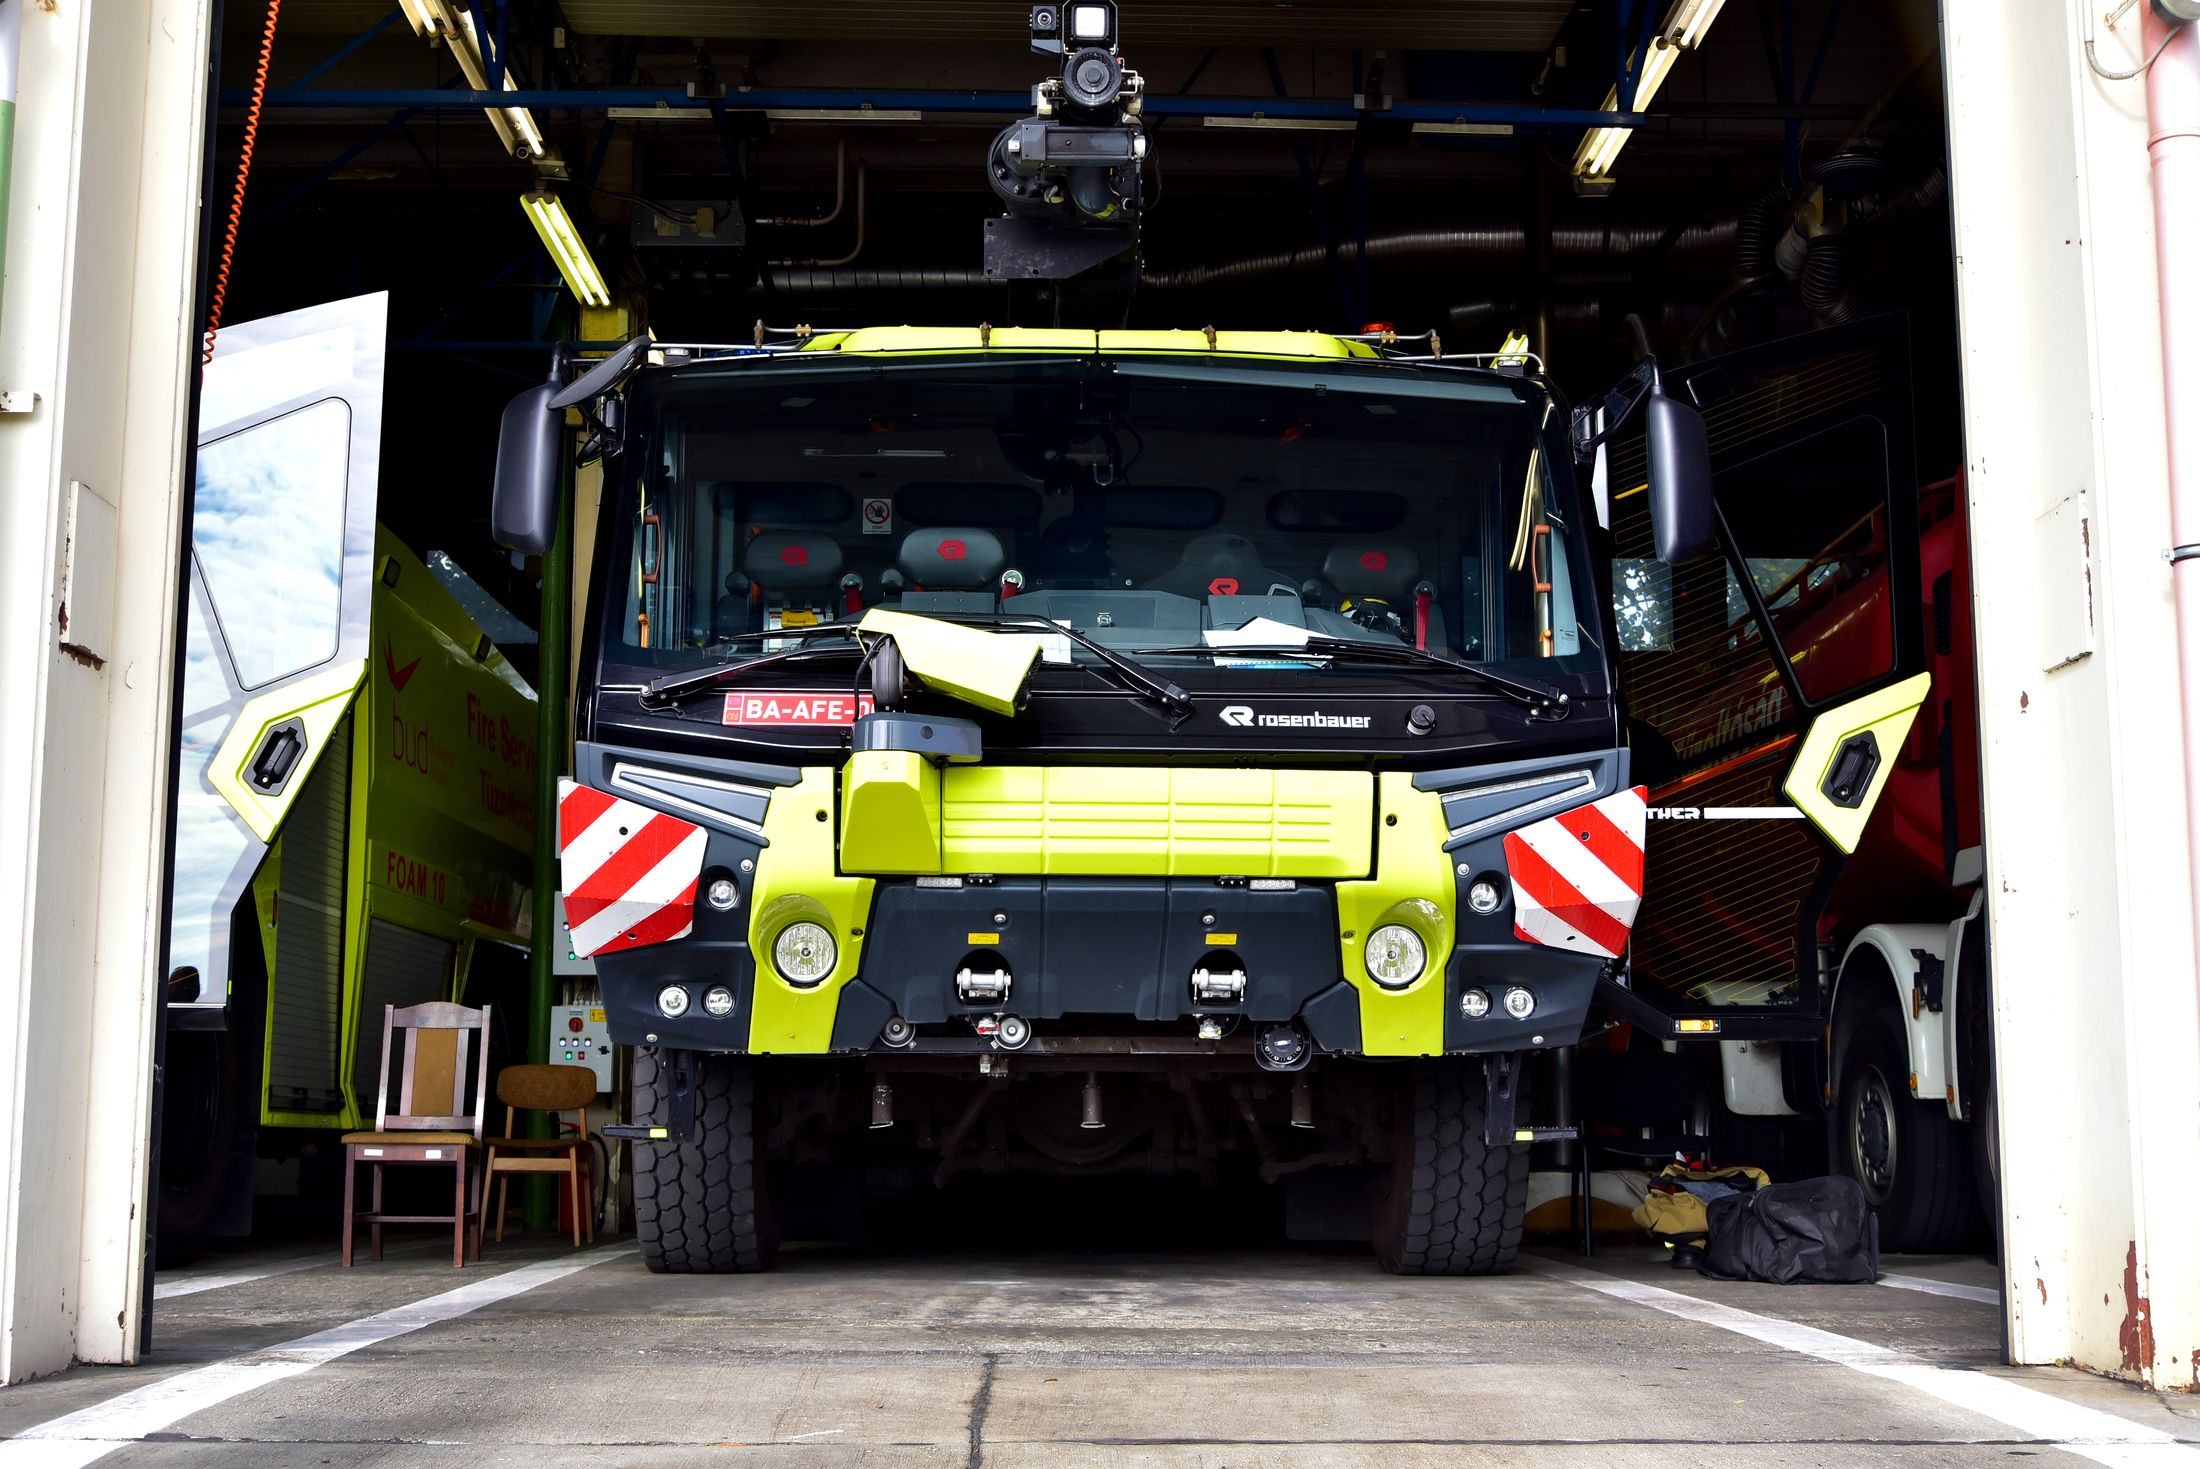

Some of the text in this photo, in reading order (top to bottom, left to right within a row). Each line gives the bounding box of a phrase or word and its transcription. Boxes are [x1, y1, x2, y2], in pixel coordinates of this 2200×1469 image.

[392, 697, 430, 775] bud
[466, 690, 498, 753] Fire
[501, 715, 537, 778] Servi
[1258, 711, 1371, 729] rosenbauer
[1645, 807, 1701, 820] THER
[387, 851, 446, 905] FOAM 10
